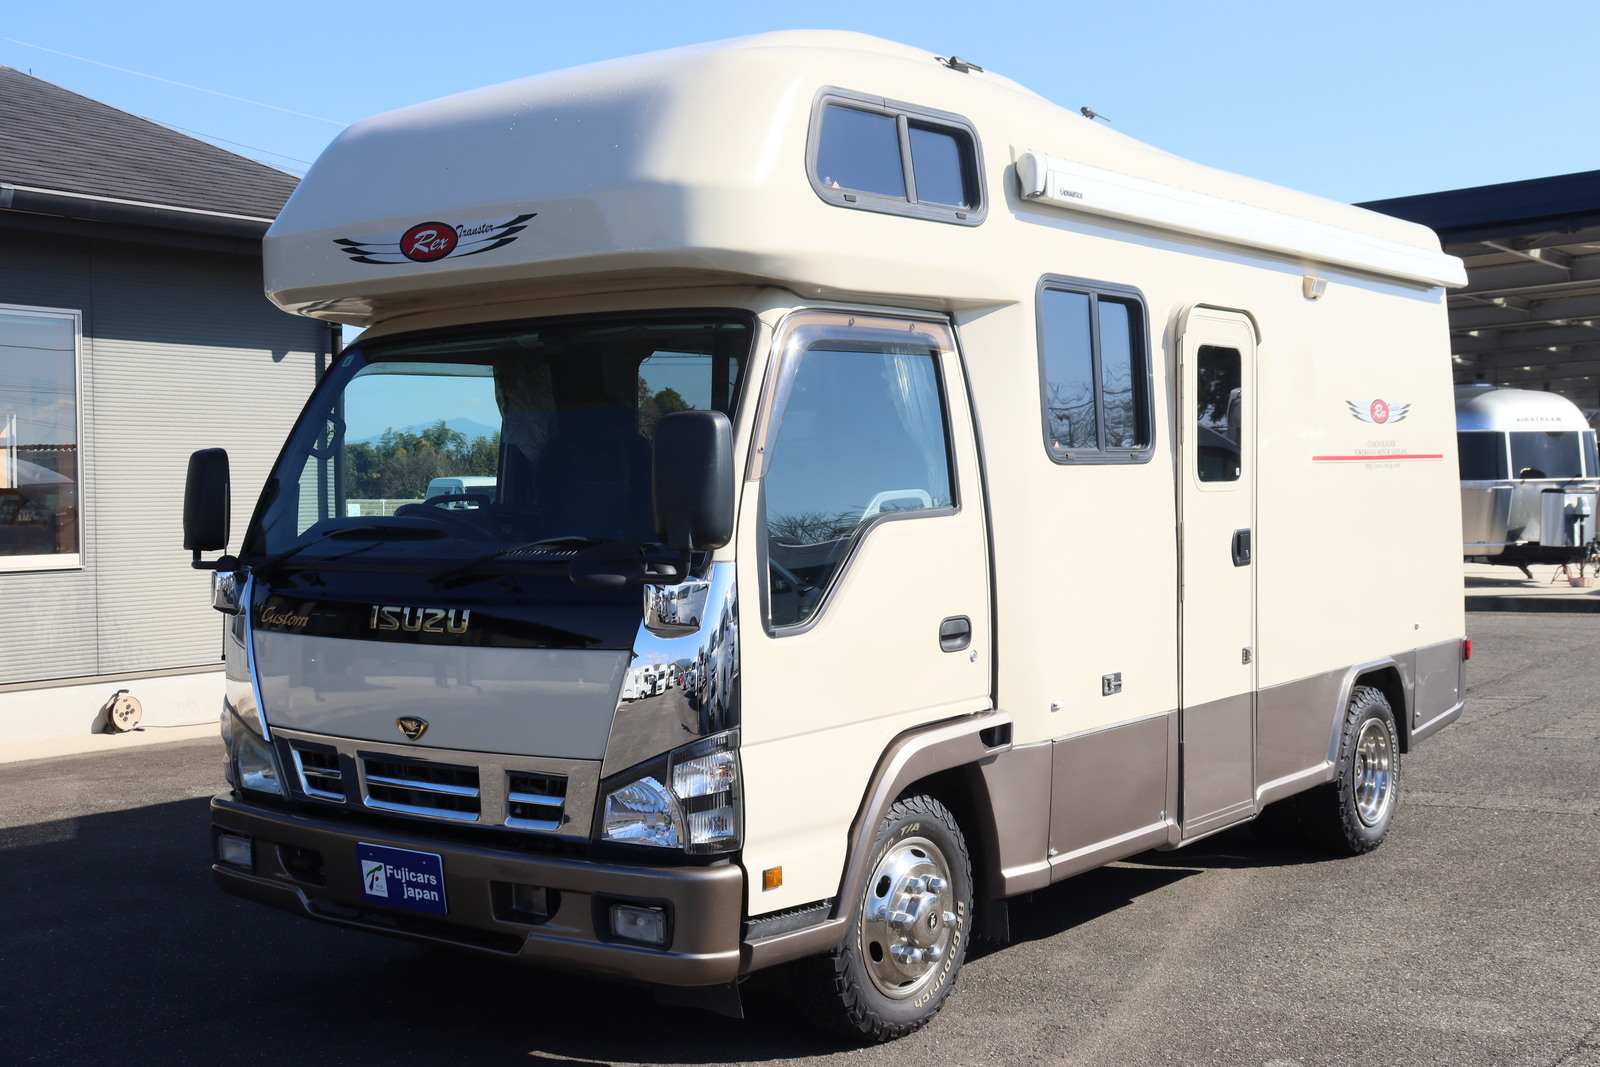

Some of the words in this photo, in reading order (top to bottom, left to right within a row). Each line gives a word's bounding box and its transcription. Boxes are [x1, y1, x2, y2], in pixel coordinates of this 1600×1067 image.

[409, 229, 449, 255] Rex
[456, 222, 494, 238] Transter
[261, 606, 309, 627] Custom
[369, 604, 471, 634] ISUZU
[900, 822, 920, 836] T/A
[385, 864, 437, 886] Fujicars
[403, 883, 439, 902] japan
[914, 900, 965, 1008] BFGoodrich
